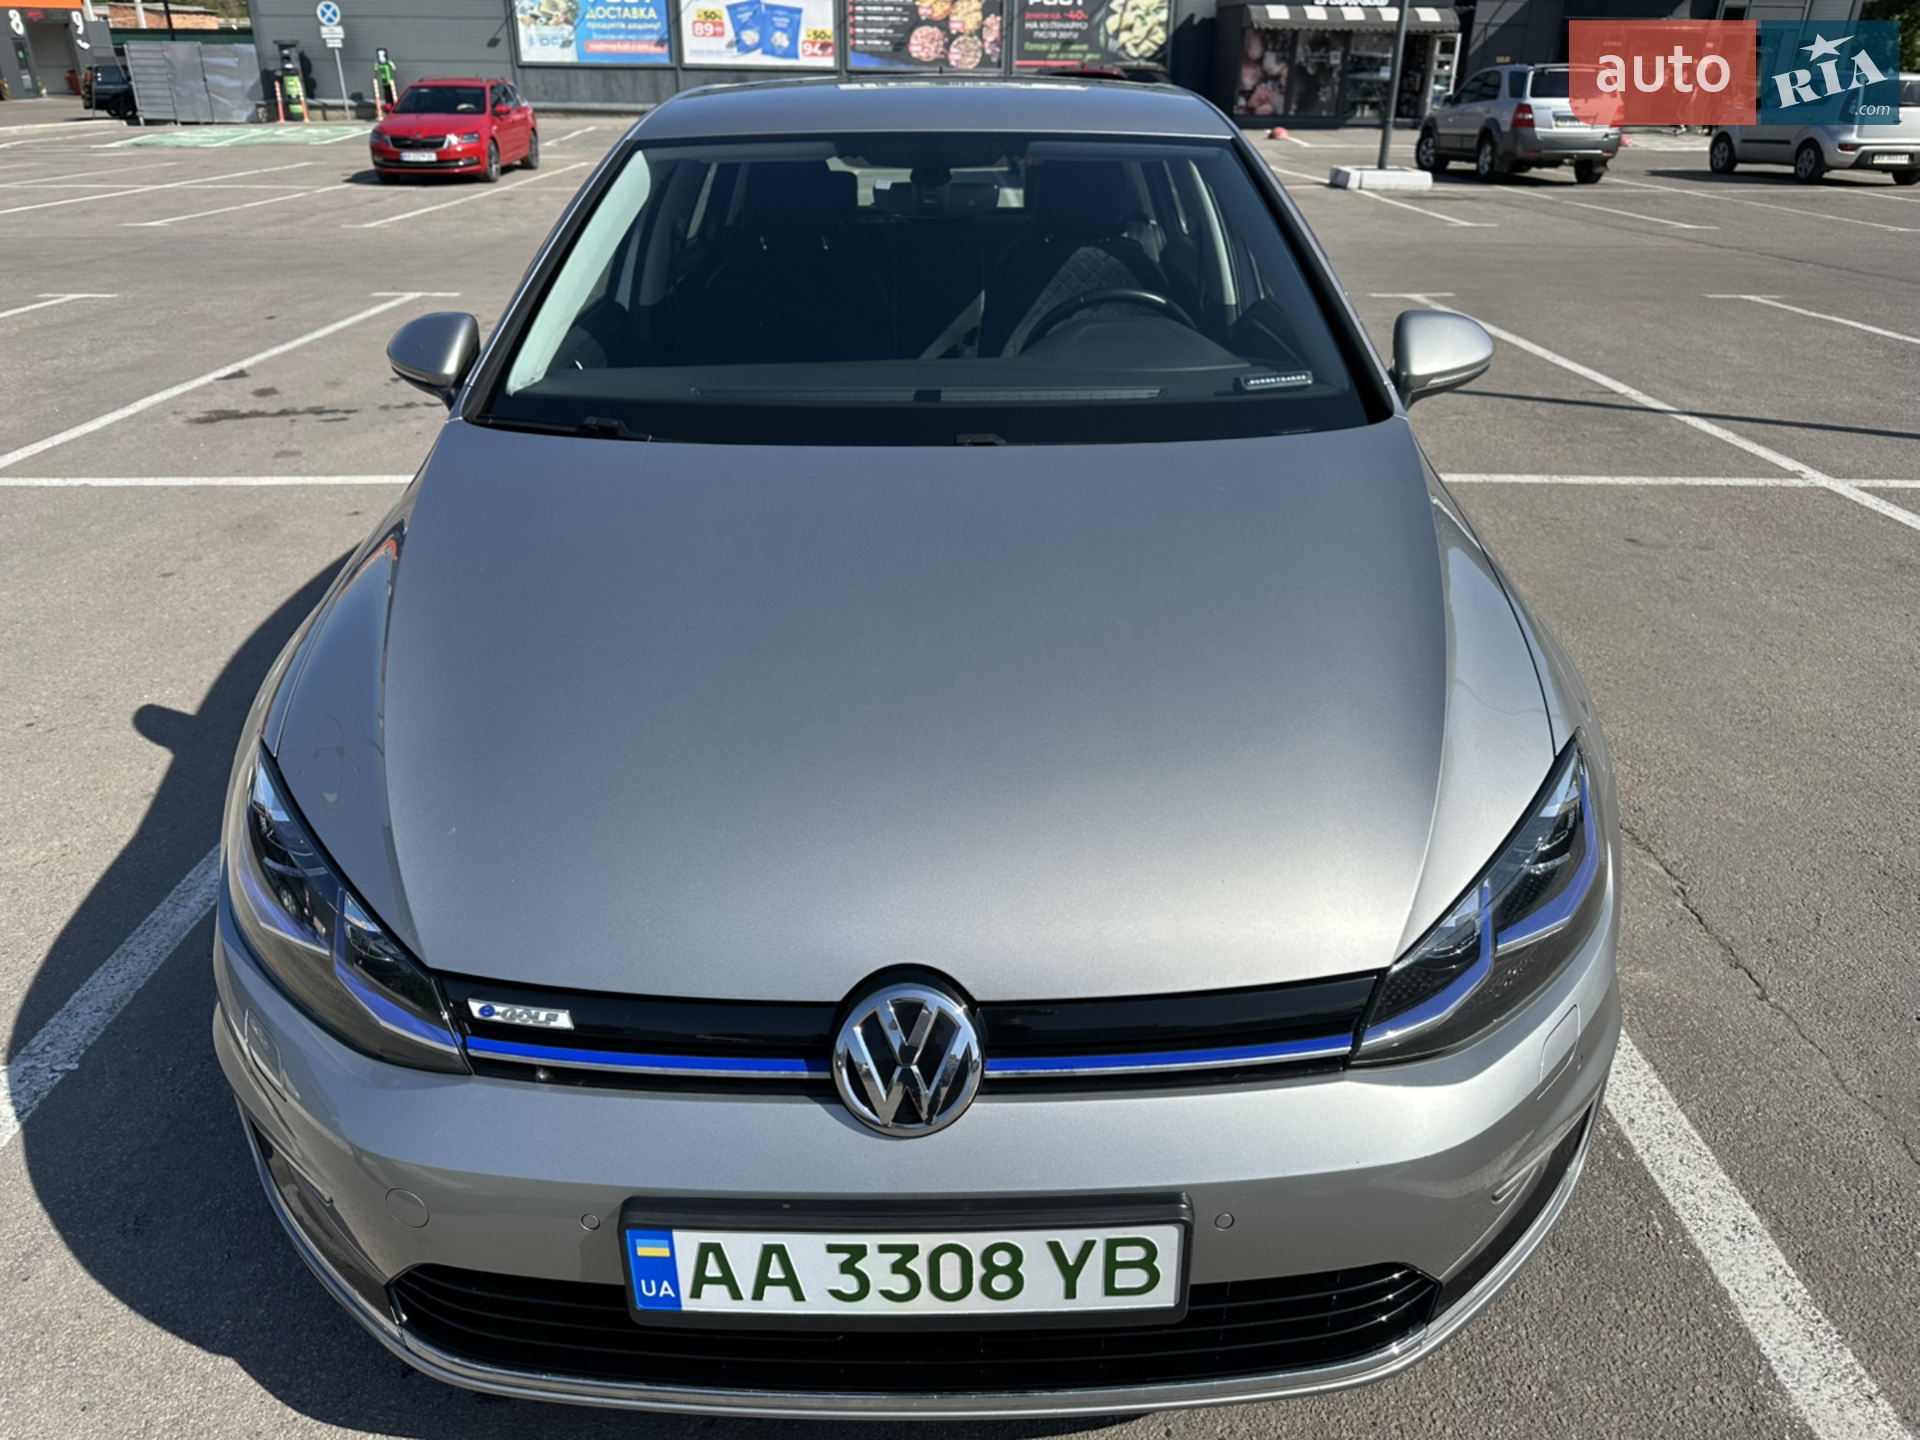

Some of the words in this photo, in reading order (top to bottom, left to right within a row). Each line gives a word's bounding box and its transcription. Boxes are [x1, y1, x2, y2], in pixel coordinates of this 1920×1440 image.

[8, 9, 24, 35] 8
[71, 10, 84, 35] 9
[585, 6, 658, 20] ДОСТАВКА
[689, 1241, 806, 1302] AA
[825, 1242, 1026, 1303] 3308
[1046, 1236, 1162, 1300] YB
[640, 1279, 676, 1298] UA
